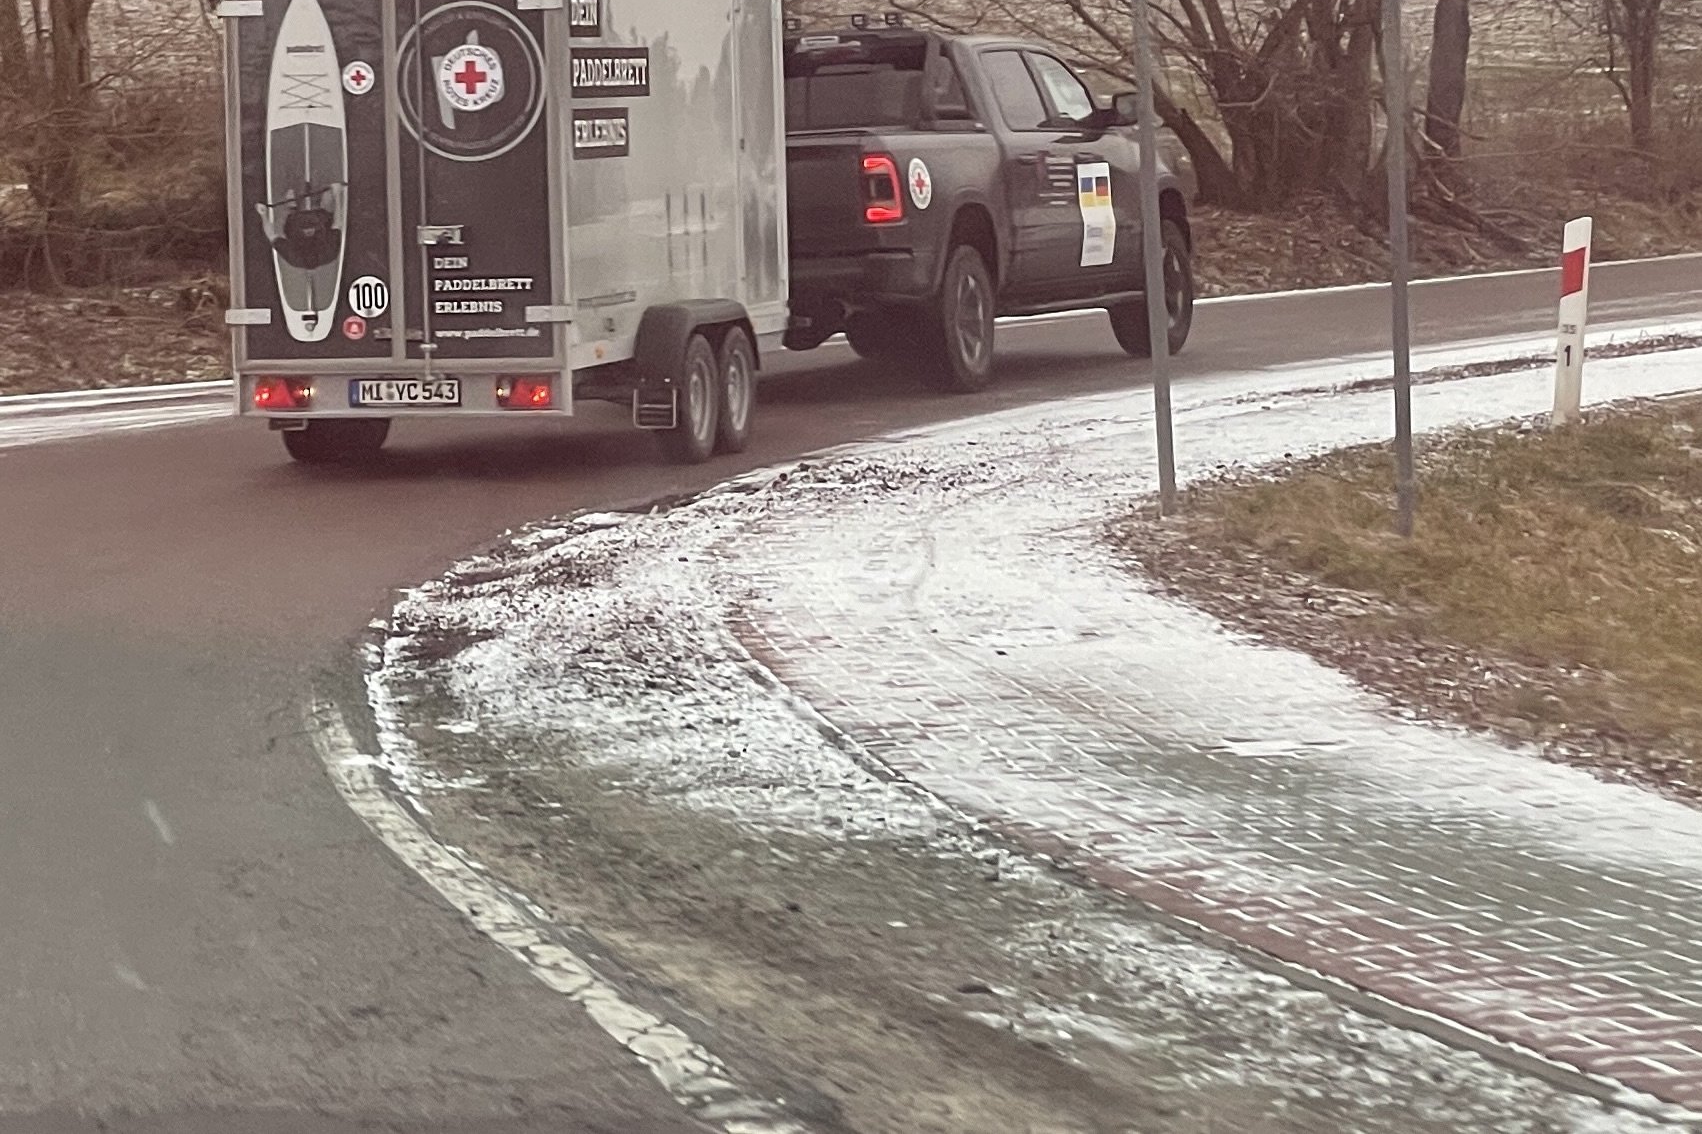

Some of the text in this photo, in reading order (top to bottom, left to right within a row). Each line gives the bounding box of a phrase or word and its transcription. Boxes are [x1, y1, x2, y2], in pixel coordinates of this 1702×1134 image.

[572, 58, 648, 87] PADDELBRETT
[433, 257, 469, 270] DEIN
[434, 277, 534, 292] PADDELBRETT
[353, 282, 385, 311] 100
[434, 300, 503, 314] ERLEBNIS
[1564, 344, 1572, 367] 1
[361, 382, 456, 401] MI YC 543
